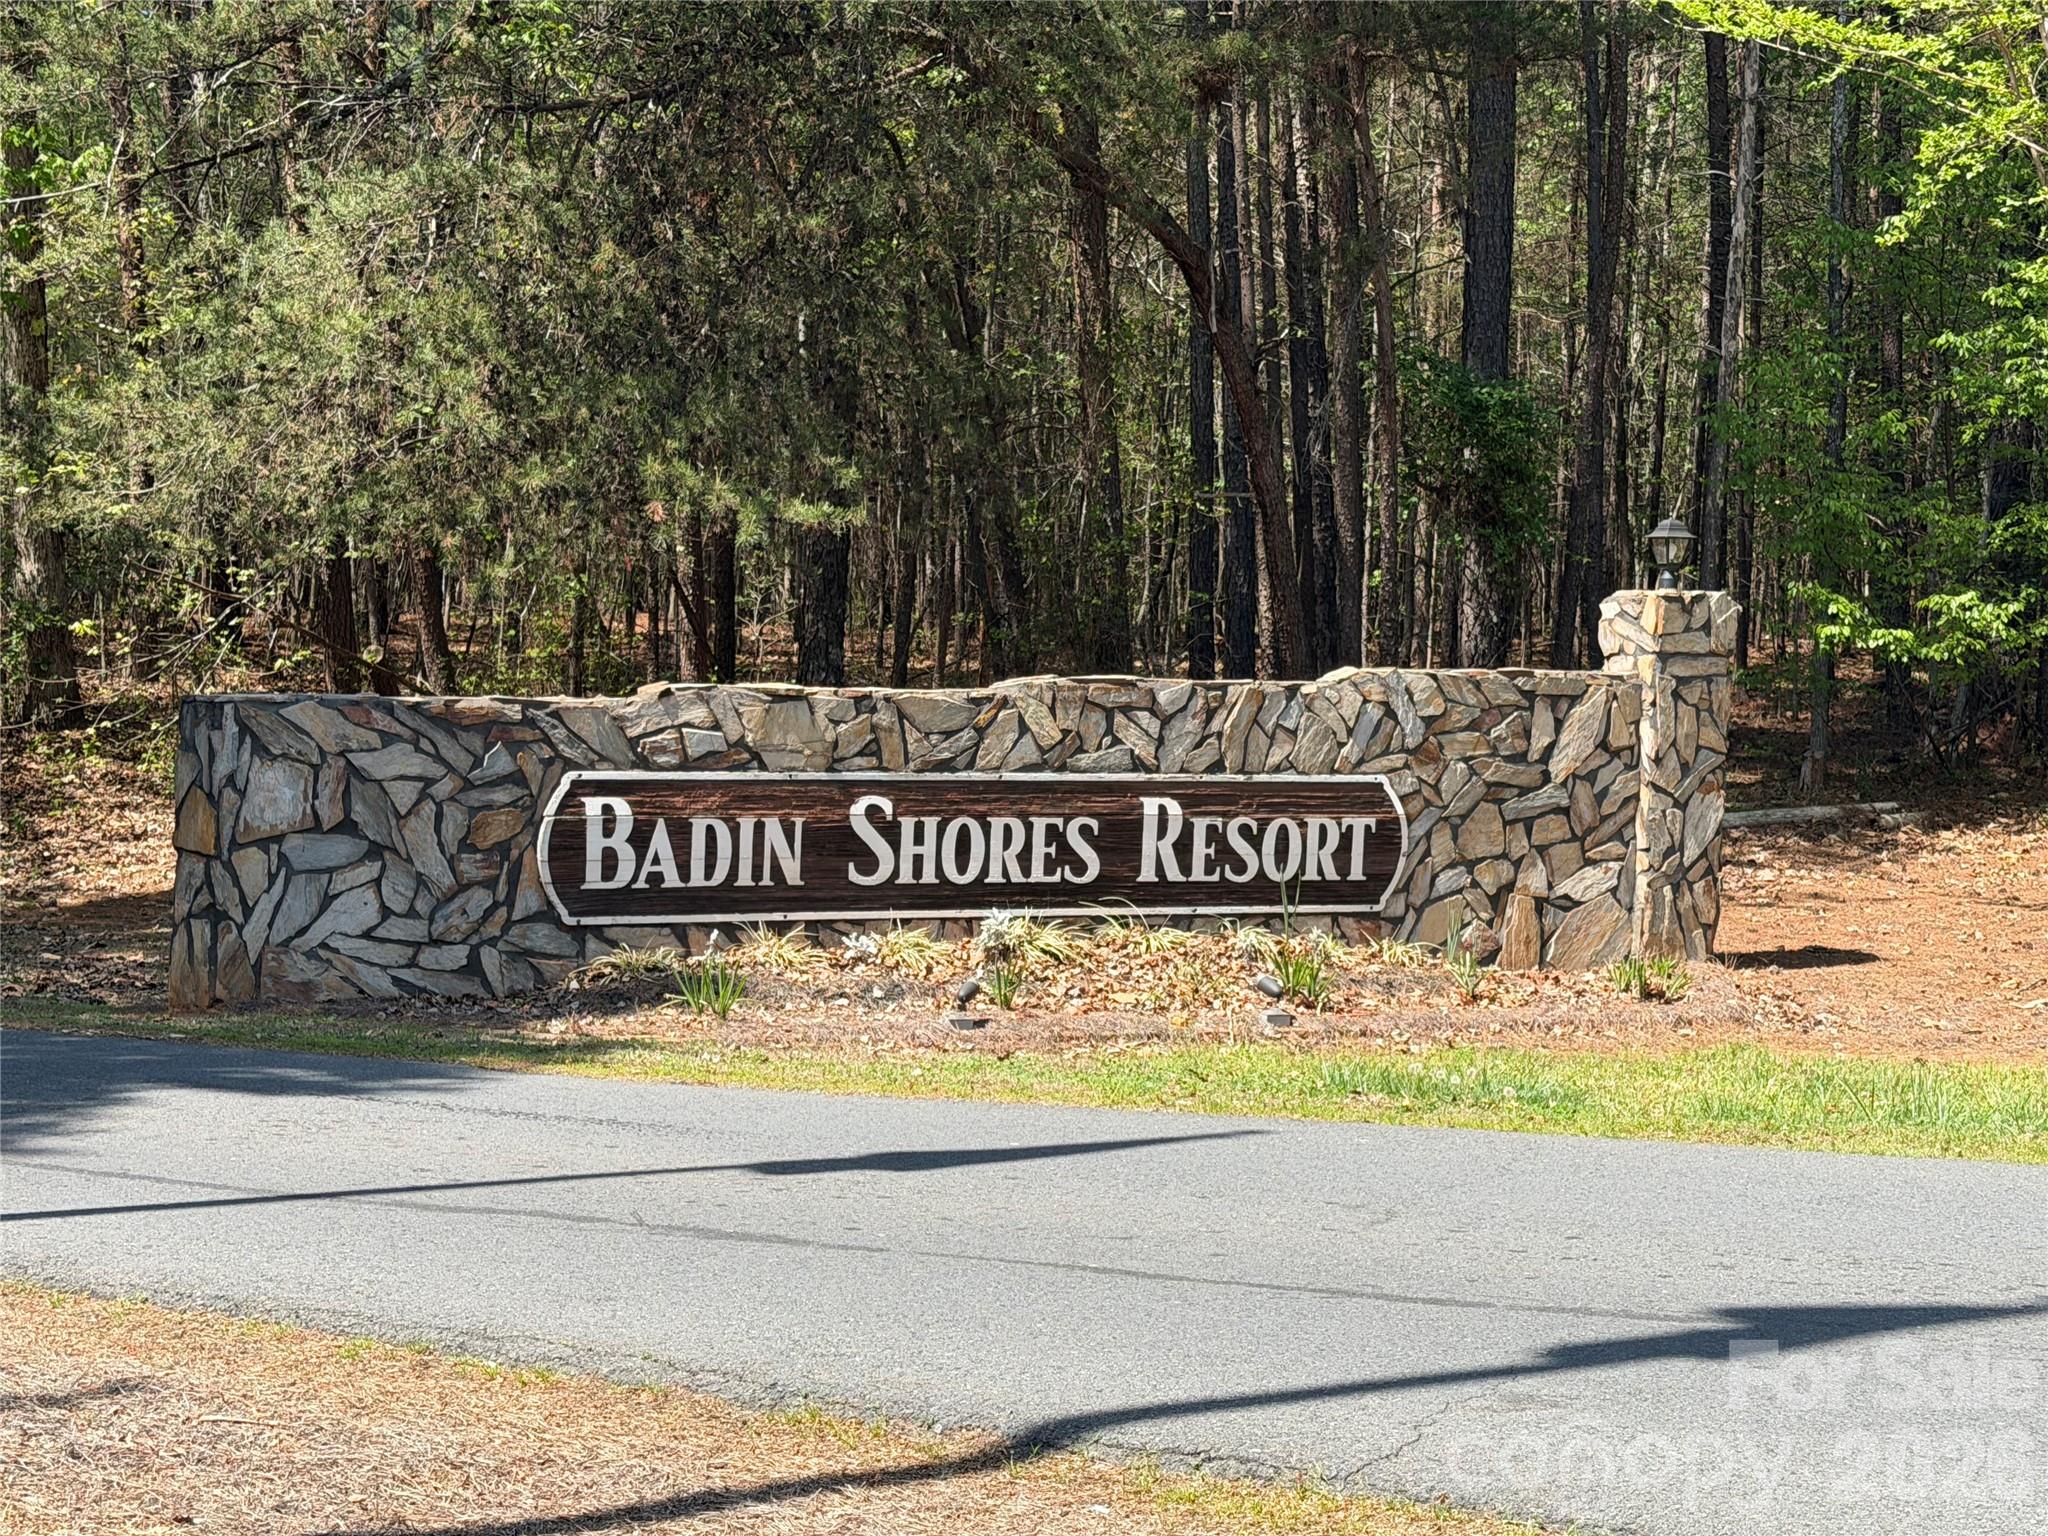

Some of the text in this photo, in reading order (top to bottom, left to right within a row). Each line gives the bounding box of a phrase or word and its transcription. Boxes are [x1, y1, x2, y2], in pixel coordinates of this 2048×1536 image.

[580, 794, 1378, 890] BADIN SHORES RESORT
